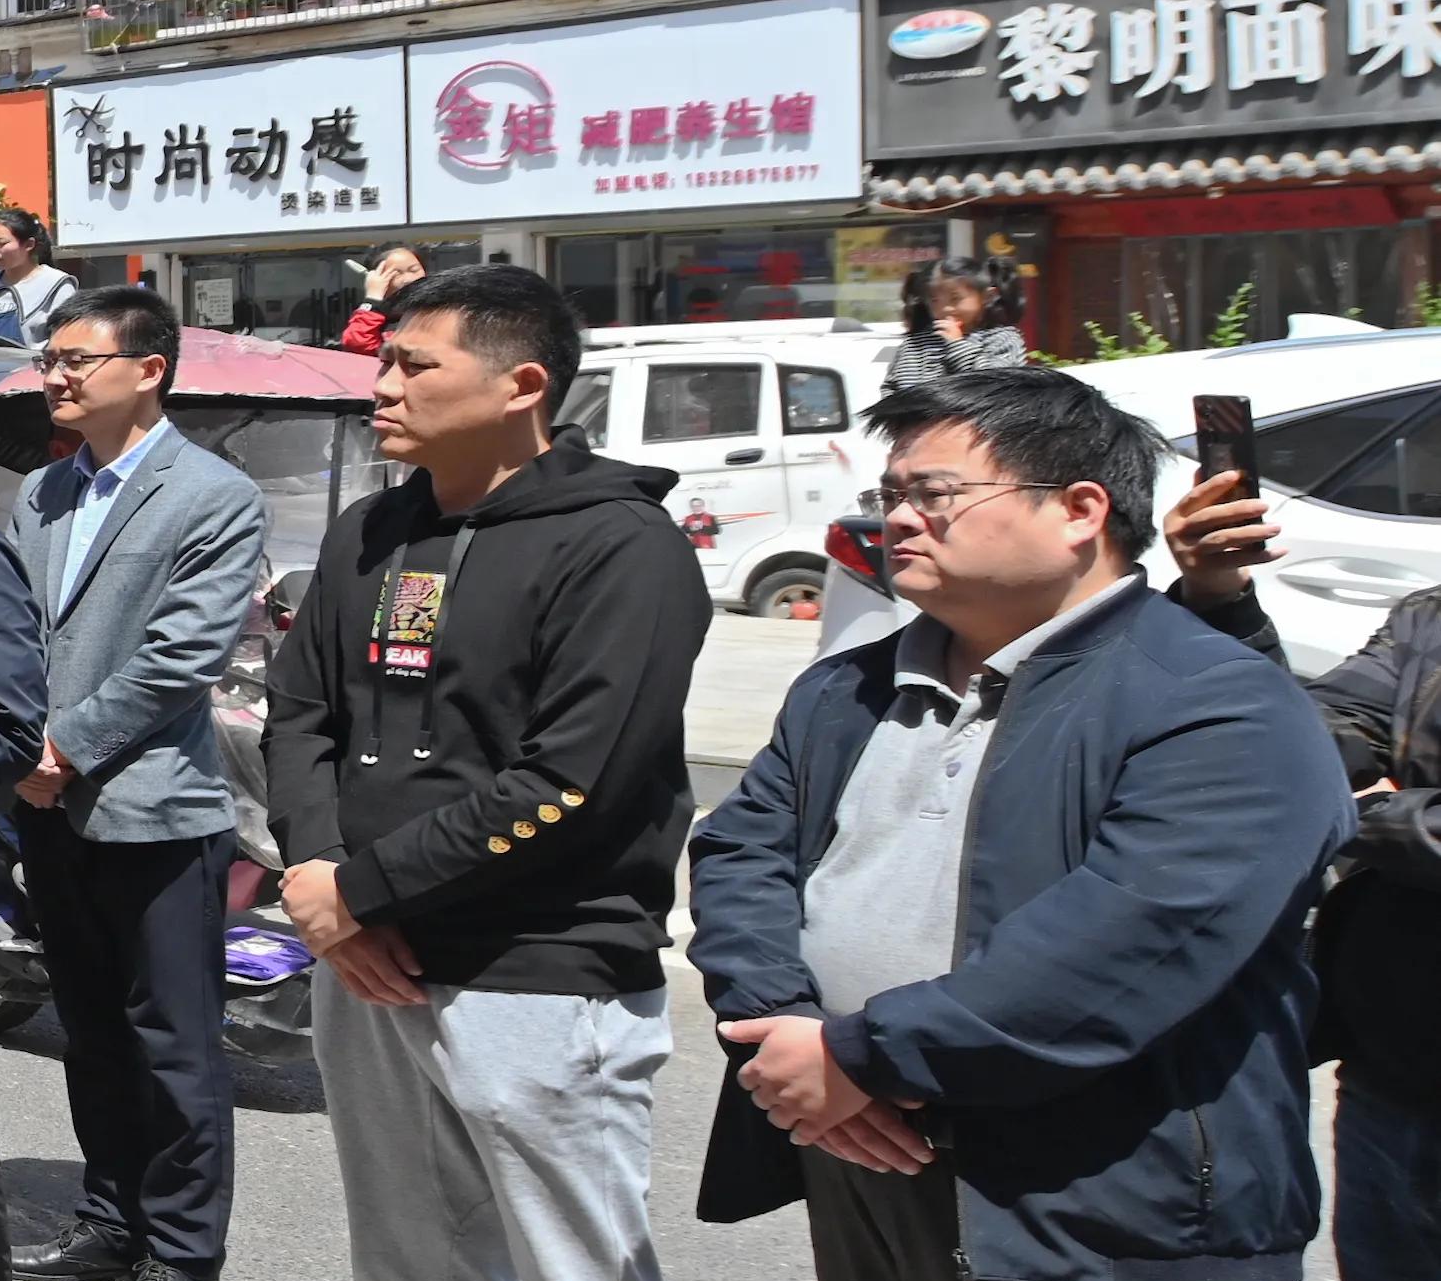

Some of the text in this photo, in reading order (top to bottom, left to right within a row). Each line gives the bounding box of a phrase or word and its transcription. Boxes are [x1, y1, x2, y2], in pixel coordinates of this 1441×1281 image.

[87, 105, 368, 191] 时尚动感
[580, 91, 815, 149] 减肥养生馆
[280, 186, 381, 211] 烫染造型
